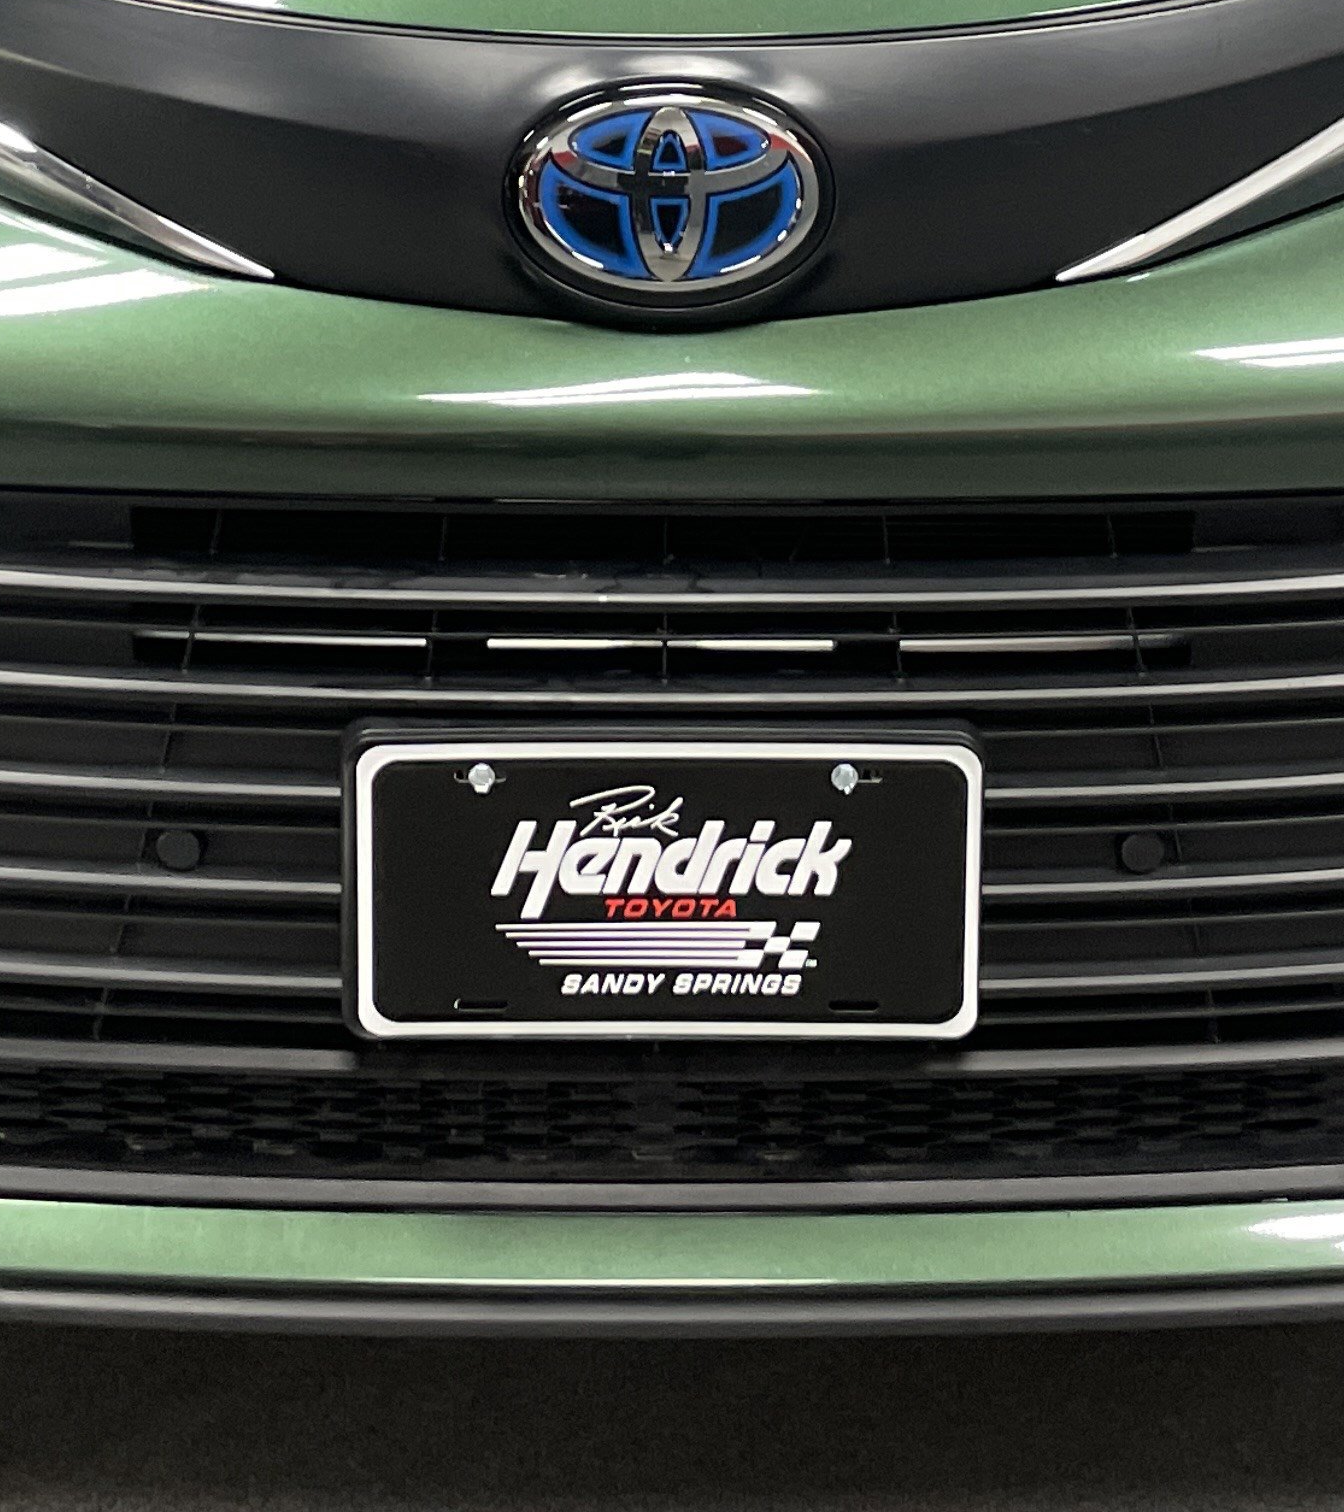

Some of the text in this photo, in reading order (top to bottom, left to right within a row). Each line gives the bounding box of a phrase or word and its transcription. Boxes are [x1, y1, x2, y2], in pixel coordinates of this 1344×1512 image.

[490, 820, 853, 920] Hendrick
[604, 898, 738, 919] TOYOTA
[561, 973, 803, 995] SANDY SPRINGS
